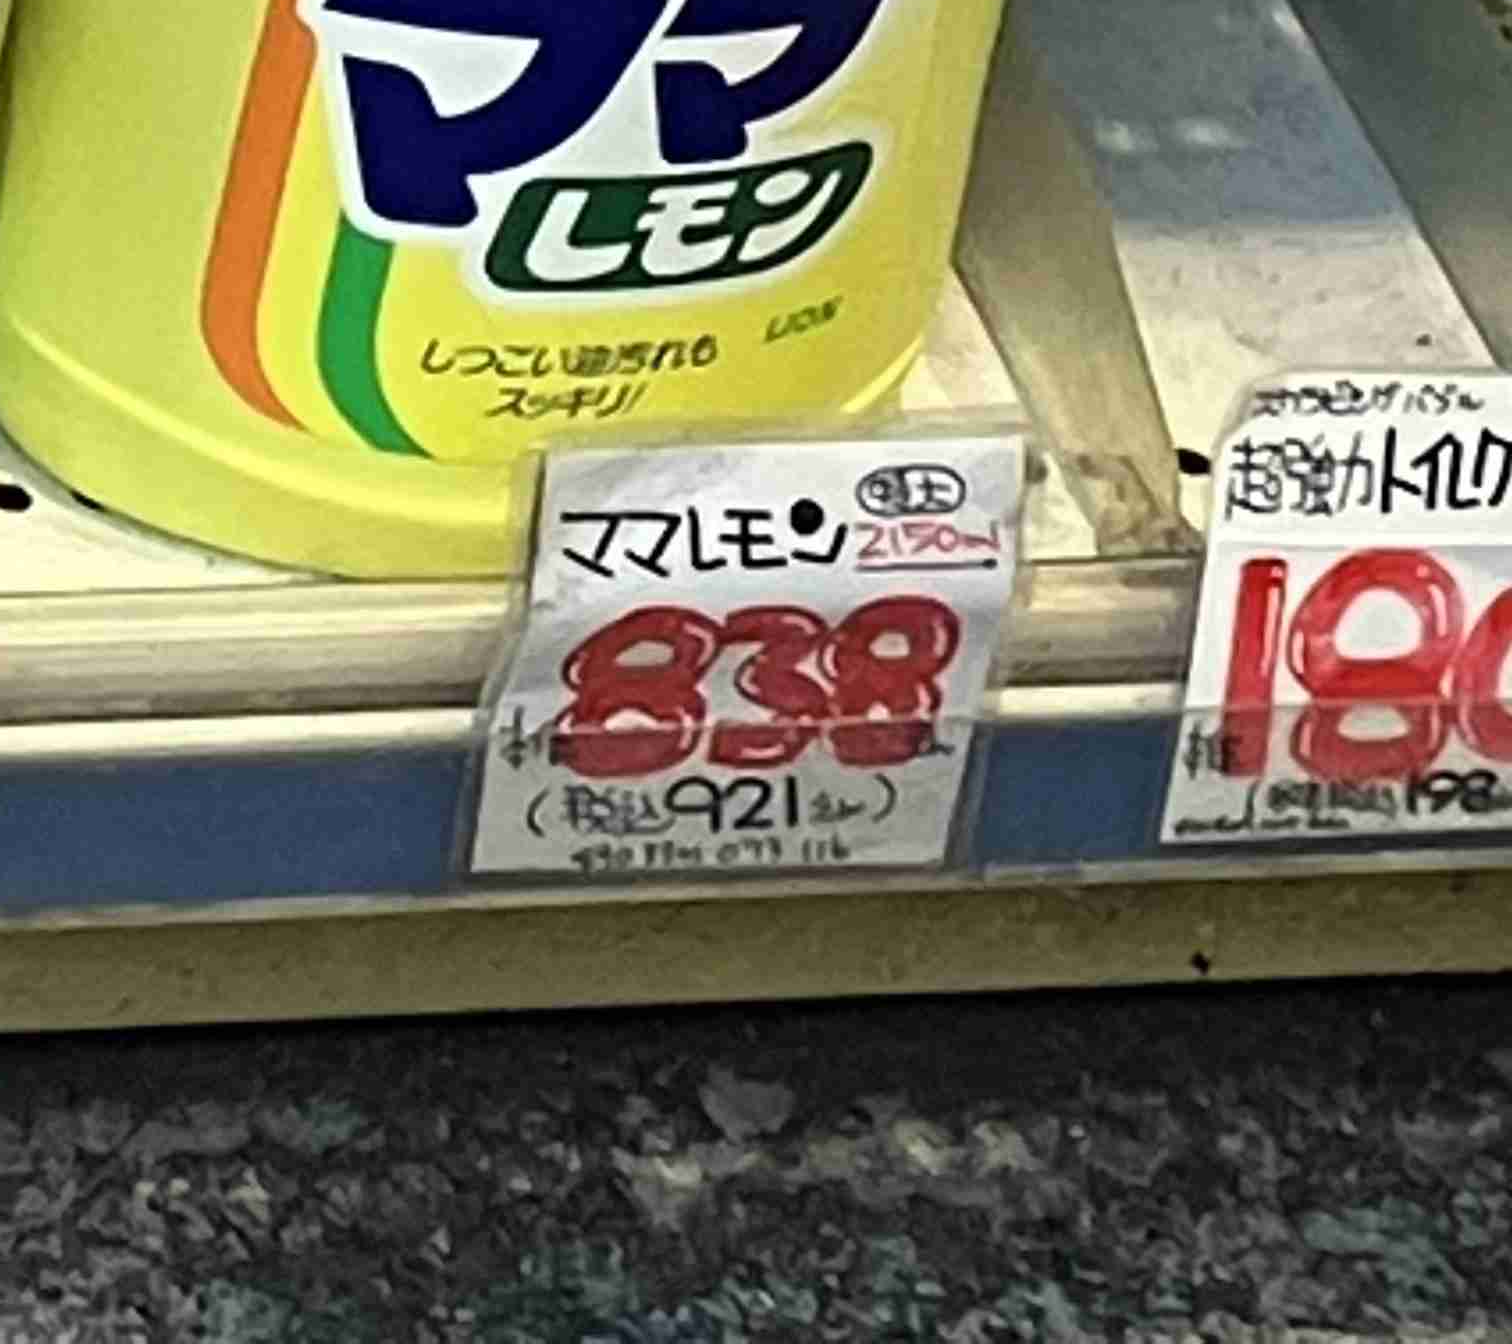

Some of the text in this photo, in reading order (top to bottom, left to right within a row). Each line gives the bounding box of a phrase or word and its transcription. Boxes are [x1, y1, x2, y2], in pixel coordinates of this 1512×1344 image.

[523, 165, 842, 282] レモン
[560, 499, 849, 577] ママレモン
[554, 595, 960, 778] 838
